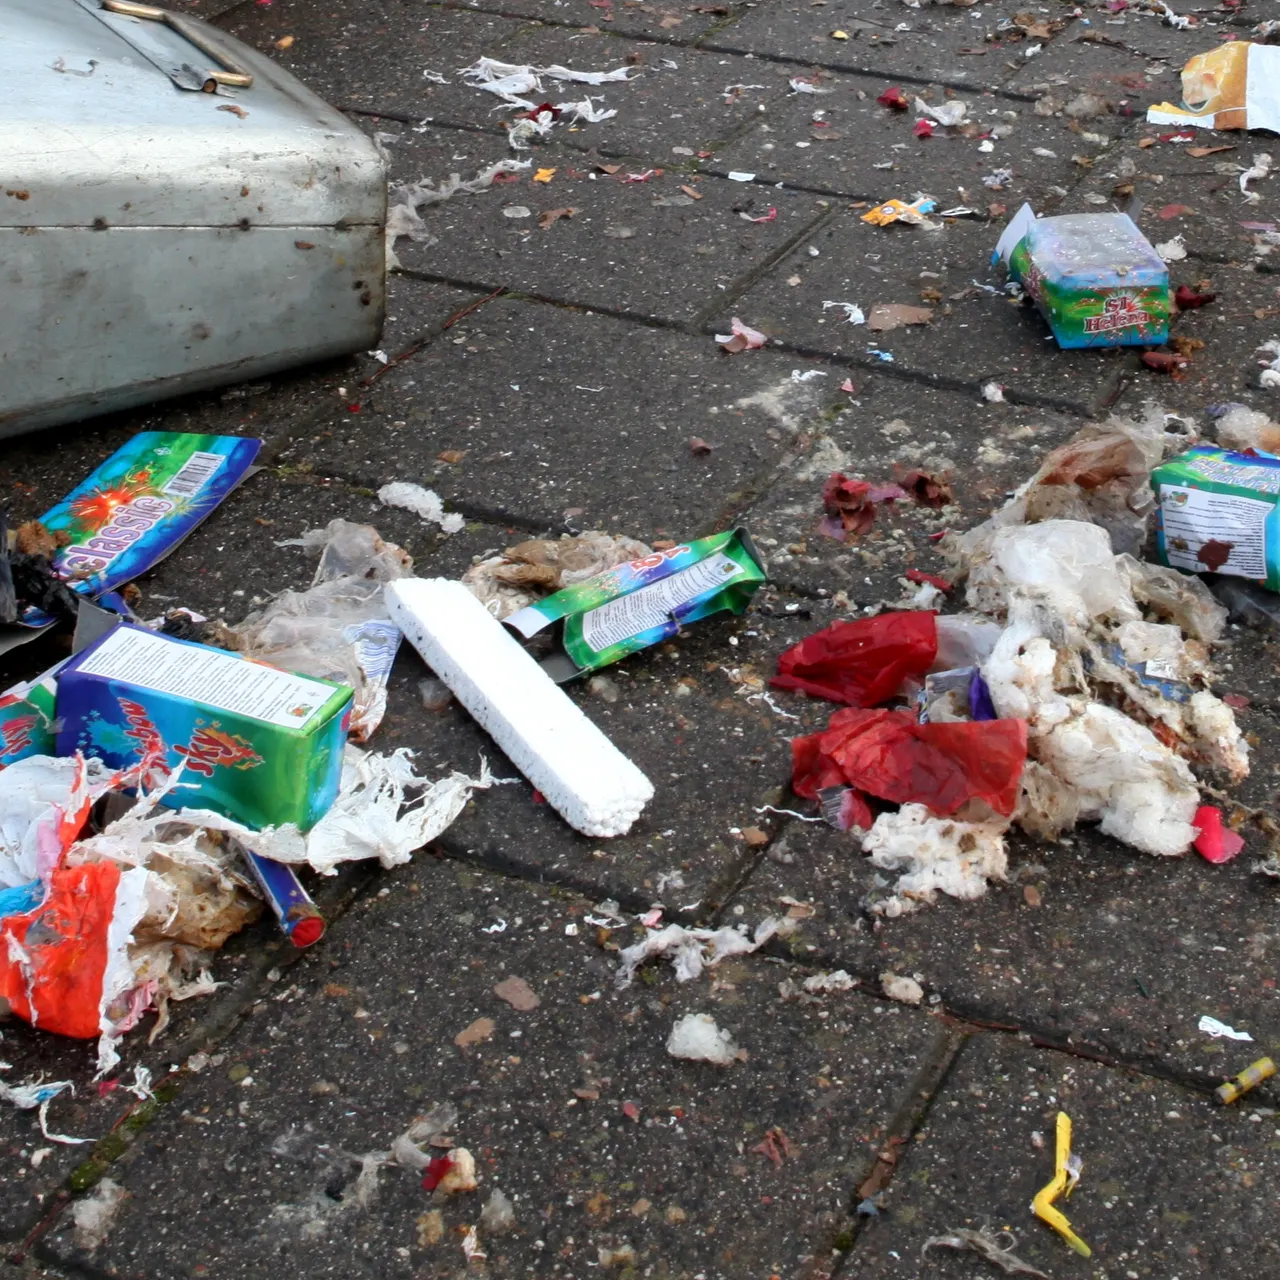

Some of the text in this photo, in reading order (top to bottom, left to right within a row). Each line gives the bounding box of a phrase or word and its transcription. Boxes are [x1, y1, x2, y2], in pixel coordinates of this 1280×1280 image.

[1086, 311, 1150, 333] Helena
[65, 497, 173, 571] classic
[172, 727, 233, 778] sky
